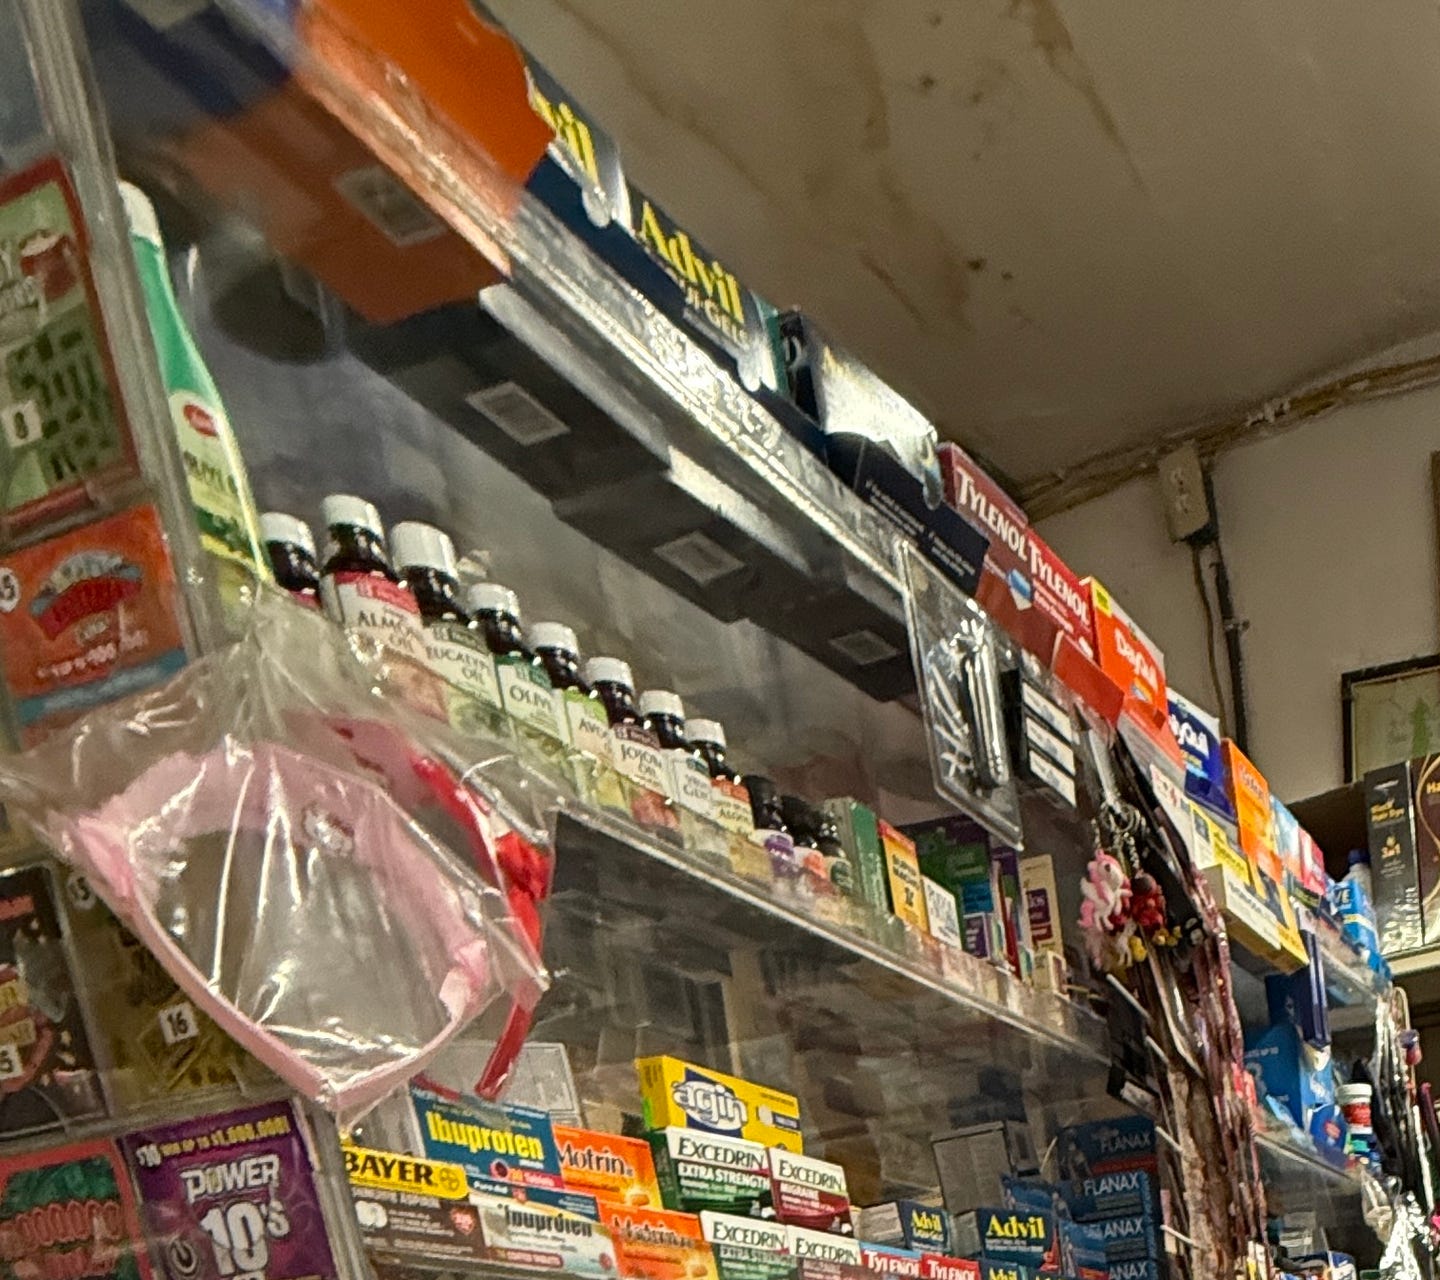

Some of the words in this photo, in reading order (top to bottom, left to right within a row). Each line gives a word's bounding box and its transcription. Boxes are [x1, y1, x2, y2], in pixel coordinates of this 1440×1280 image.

[636, 199, 745, 326] Advil
[956, 466, 1028, 563] TYLENOL
[1027, 536, 1091, 628] TYLENOL
[425, 1109, 545, 1162] Ibuprofen
[343, 1150, 433, 1187] BAYER
[677, 1136, 766, 1171] EXCEDRIN
[180, 1154, 279, 1204] POWER
[778, 1158, 844, 1190] EXCEDRIN
[1083, 1172, 1141, 1197] FLANAX
[712, 1220, 786, 1250] EXCEDRIN
[910, 1208, 944, 1233] Advil
[986, 1213, 1046, 1242] Advil
[1103, 1217, 1144, 1237] ANAX
[795, 1236, 860, 1266] EXCEDRIN
